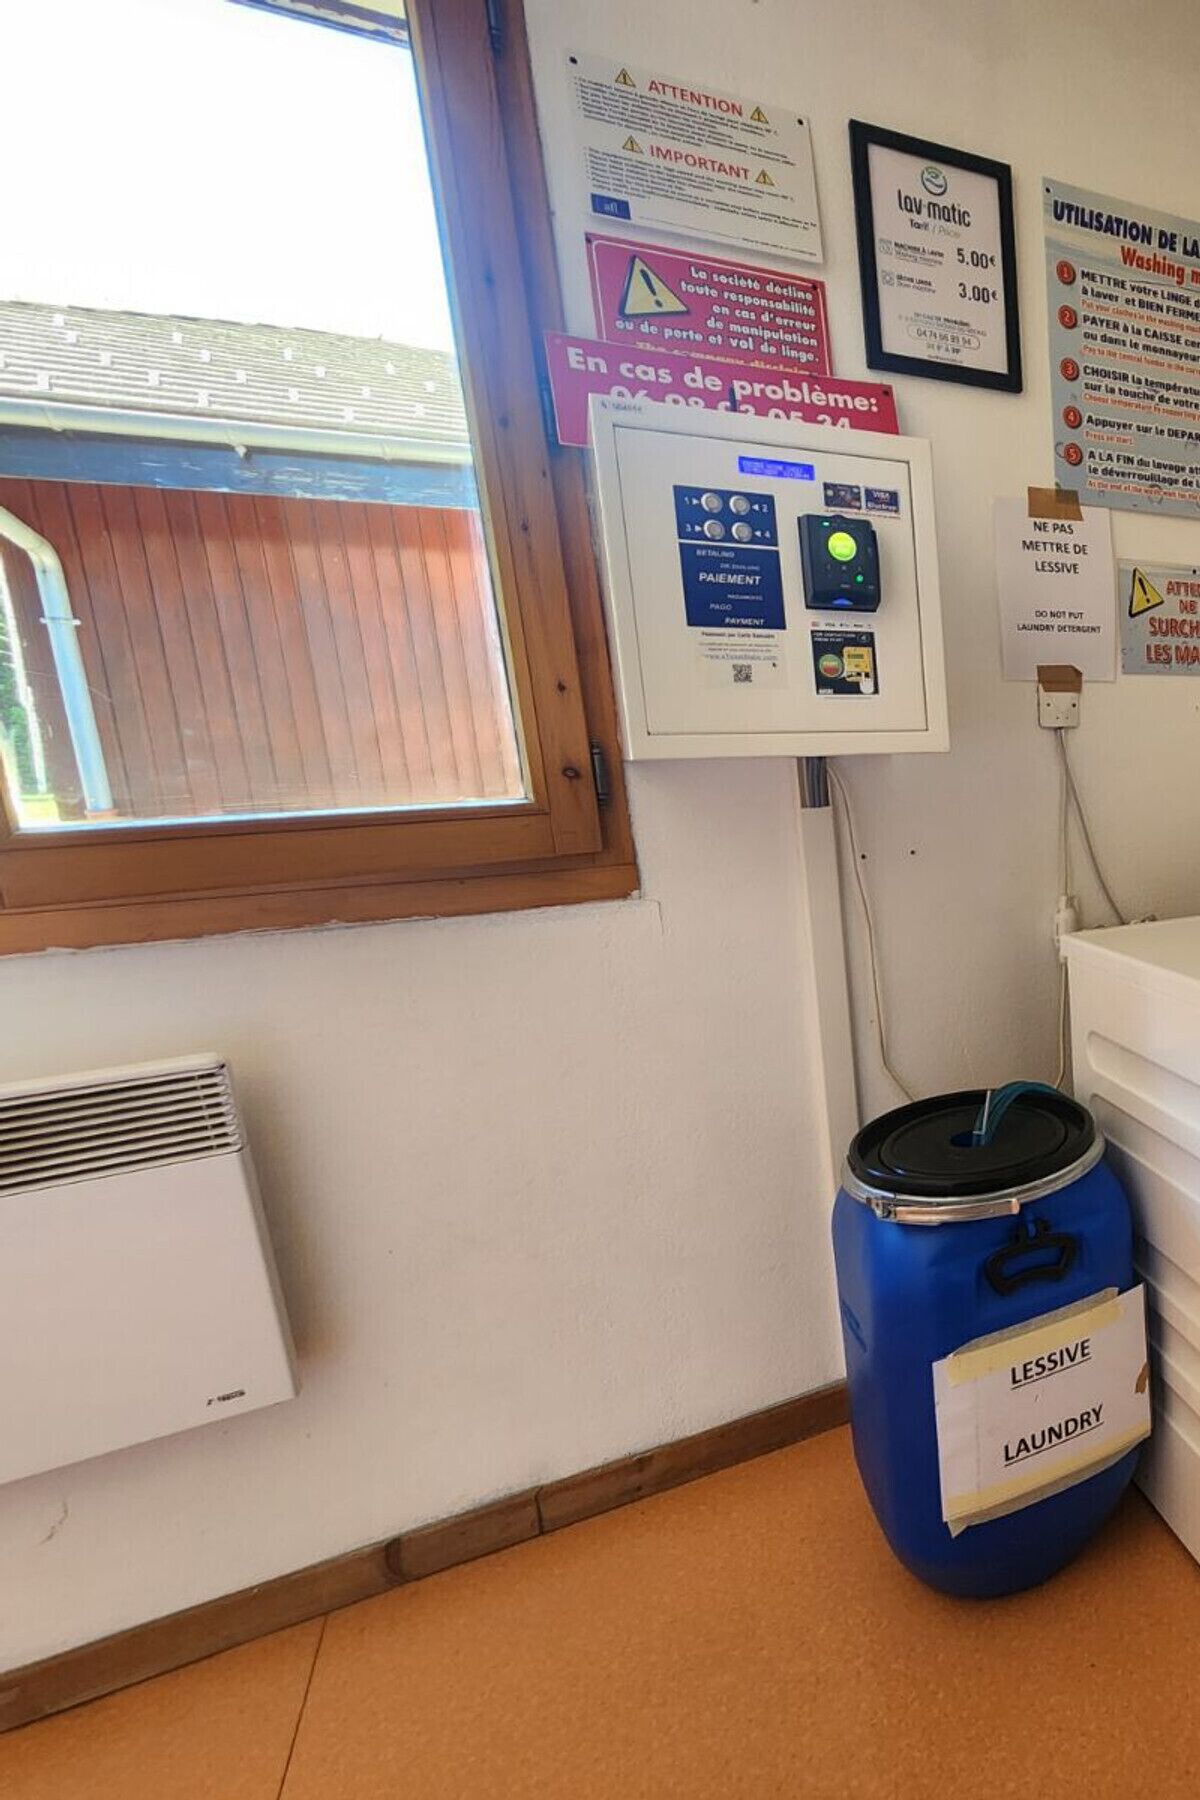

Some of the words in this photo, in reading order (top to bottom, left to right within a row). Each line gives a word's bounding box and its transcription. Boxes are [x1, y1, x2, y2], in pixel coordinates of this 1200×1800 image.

[648, 80, 743, 117] ATTENTION
[650, 145, 750, 180] IMPORTANT
[1053, 200, 1152, 246] UTILISATION
[1158, 229, 1177, 252] DE
[1183, 236, 1200, 260] LA
[957, 248, 997, 269] 5.00€
[1120, 245, 1185, 286] Washing
[690, 266, 707, 280] La
[713, 272, 761, 291] société
[766, 282, 813, 301] décline
[958, 283, 998, 304] 3.00€
[1080, 269, 1127, 291] METTRE
[1130, 282, 1157, 298] votre
[1161, 289, 1191, 307] LINGE
[680, 280, 719, 298] toute
[723, 290, 816, 317] responsabilité
[1091, 289, 1119, 302] laver
[1125, 296, 1137, 307] et
[1138, 298, 1164, 315] BIEN
[712, 303, 730, 315] en
[734, 307, 756, 320] cas
[761, 311, 817, 331] d'erreur
[1083, 314, 1120, 331] PAYER
[1123, 323, 1129, 333] à
[1131, 324, 1142, 335] la
[1144, 327, 1182, 345] CAISSE
[615, 319, 634, 330] ou
[640, 320, 658, 334] de
[708, 330, 723, 345] et
[730, 337, 754, 351] vol
[760, 341, 778, 354] de
[781, 345, 819, 363] linge.
[706, 317, 724, 330] de
[729, 322, 818, 347] manipulation
[1084, 331, 1098, 342] ou
[1100, 333, 1127, 348] dans
[1129, 338, 1140, 351] le
[567, 346, 608, 374] En
[619, 359, 672, 384] cas
[684, 365, 723, 392] de
[732, 378, 879, 413] problème:
[1083, 365, 1130, 384] CHOISIR
[1132, 374, 1142, 386] la
[1084, 381, 1101, 393] sur
[1105, 383, 1116, 395] la
[1118, 387, 1156, 402] touche
[1158, 392, 1171, 405] de
[1173, 397, 1200, 410] votre
[1086, 414, 1133, 430] Appuyer
[1136, 424, 1152, 433] sur
[1155, 424, 1165, 436] le
[1088, 450, 1096, 460] A
[1098, 452, 1113, 463] LA
[1116, 454, 1135, 465] FIN
[1137, 457, 1150, 467] du
[1152, 458, 1187, 475] lavage
[1088, 464, 1099, 475] le
[1101, 466, 1180, 488] déverrouillage
[1182, 475, 1194, 487] de
[1033, 521, 1048, 533] NE
[1052, 522, 1074, 535] PAS
[1022, 540, 1070, 554] METTRE
[1073, 543, 1088, 555] DE
[699, 572, 762, 585] PAIEMENT
[1034, 561, 1079, 574] LESSIVE
[1035, 610, 1047, 618] DO
[1050, 610, 1065, 619] NOT
[1068, 611, 1083, 619] PUT
[1179, 600, 1197, 614] NE
[725, 617, 765, 625] PAYMENT
[1017, 624, 1055, 633] LAUNDRY
[1057, 624, 1101, 633] DETERGENT
[1146, 643, 1171, 664] LES
[1011, 1339, 1092, 1386] LESSIVE
[1004, 1404, 1104, 1464] LAUNDRY
